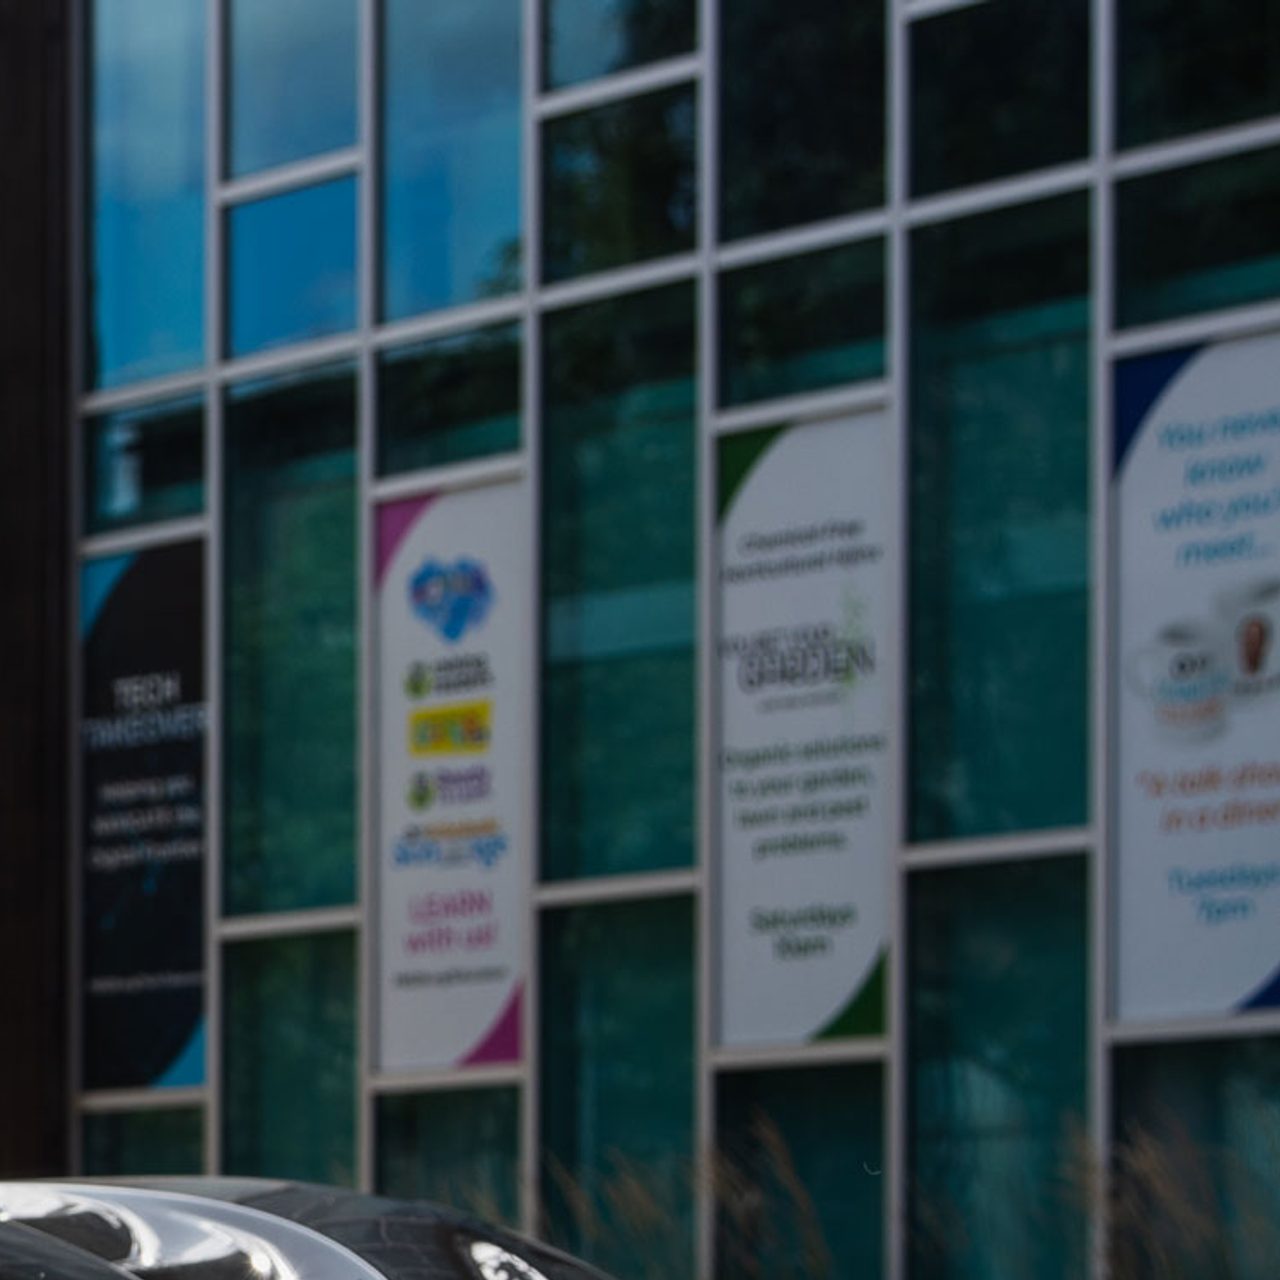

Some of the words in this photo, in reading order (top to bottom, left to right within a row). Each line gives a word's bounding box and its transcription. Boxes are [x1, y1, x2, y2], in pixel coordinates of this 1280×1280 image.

[1157, 422, 1205, 450] You
[1185, 453, 1266, 487] know
[1153, 499, 1215, 533] who
[738, 636, 876, 692] GARDEN
[114, 672, 181, 707] TECH
[1228, 762, 1280, 790] sho
[408, 890, 493, 924] LEARN
[749, 902, 859, 935] Saturdays
[404, 925, 455, 955] with
